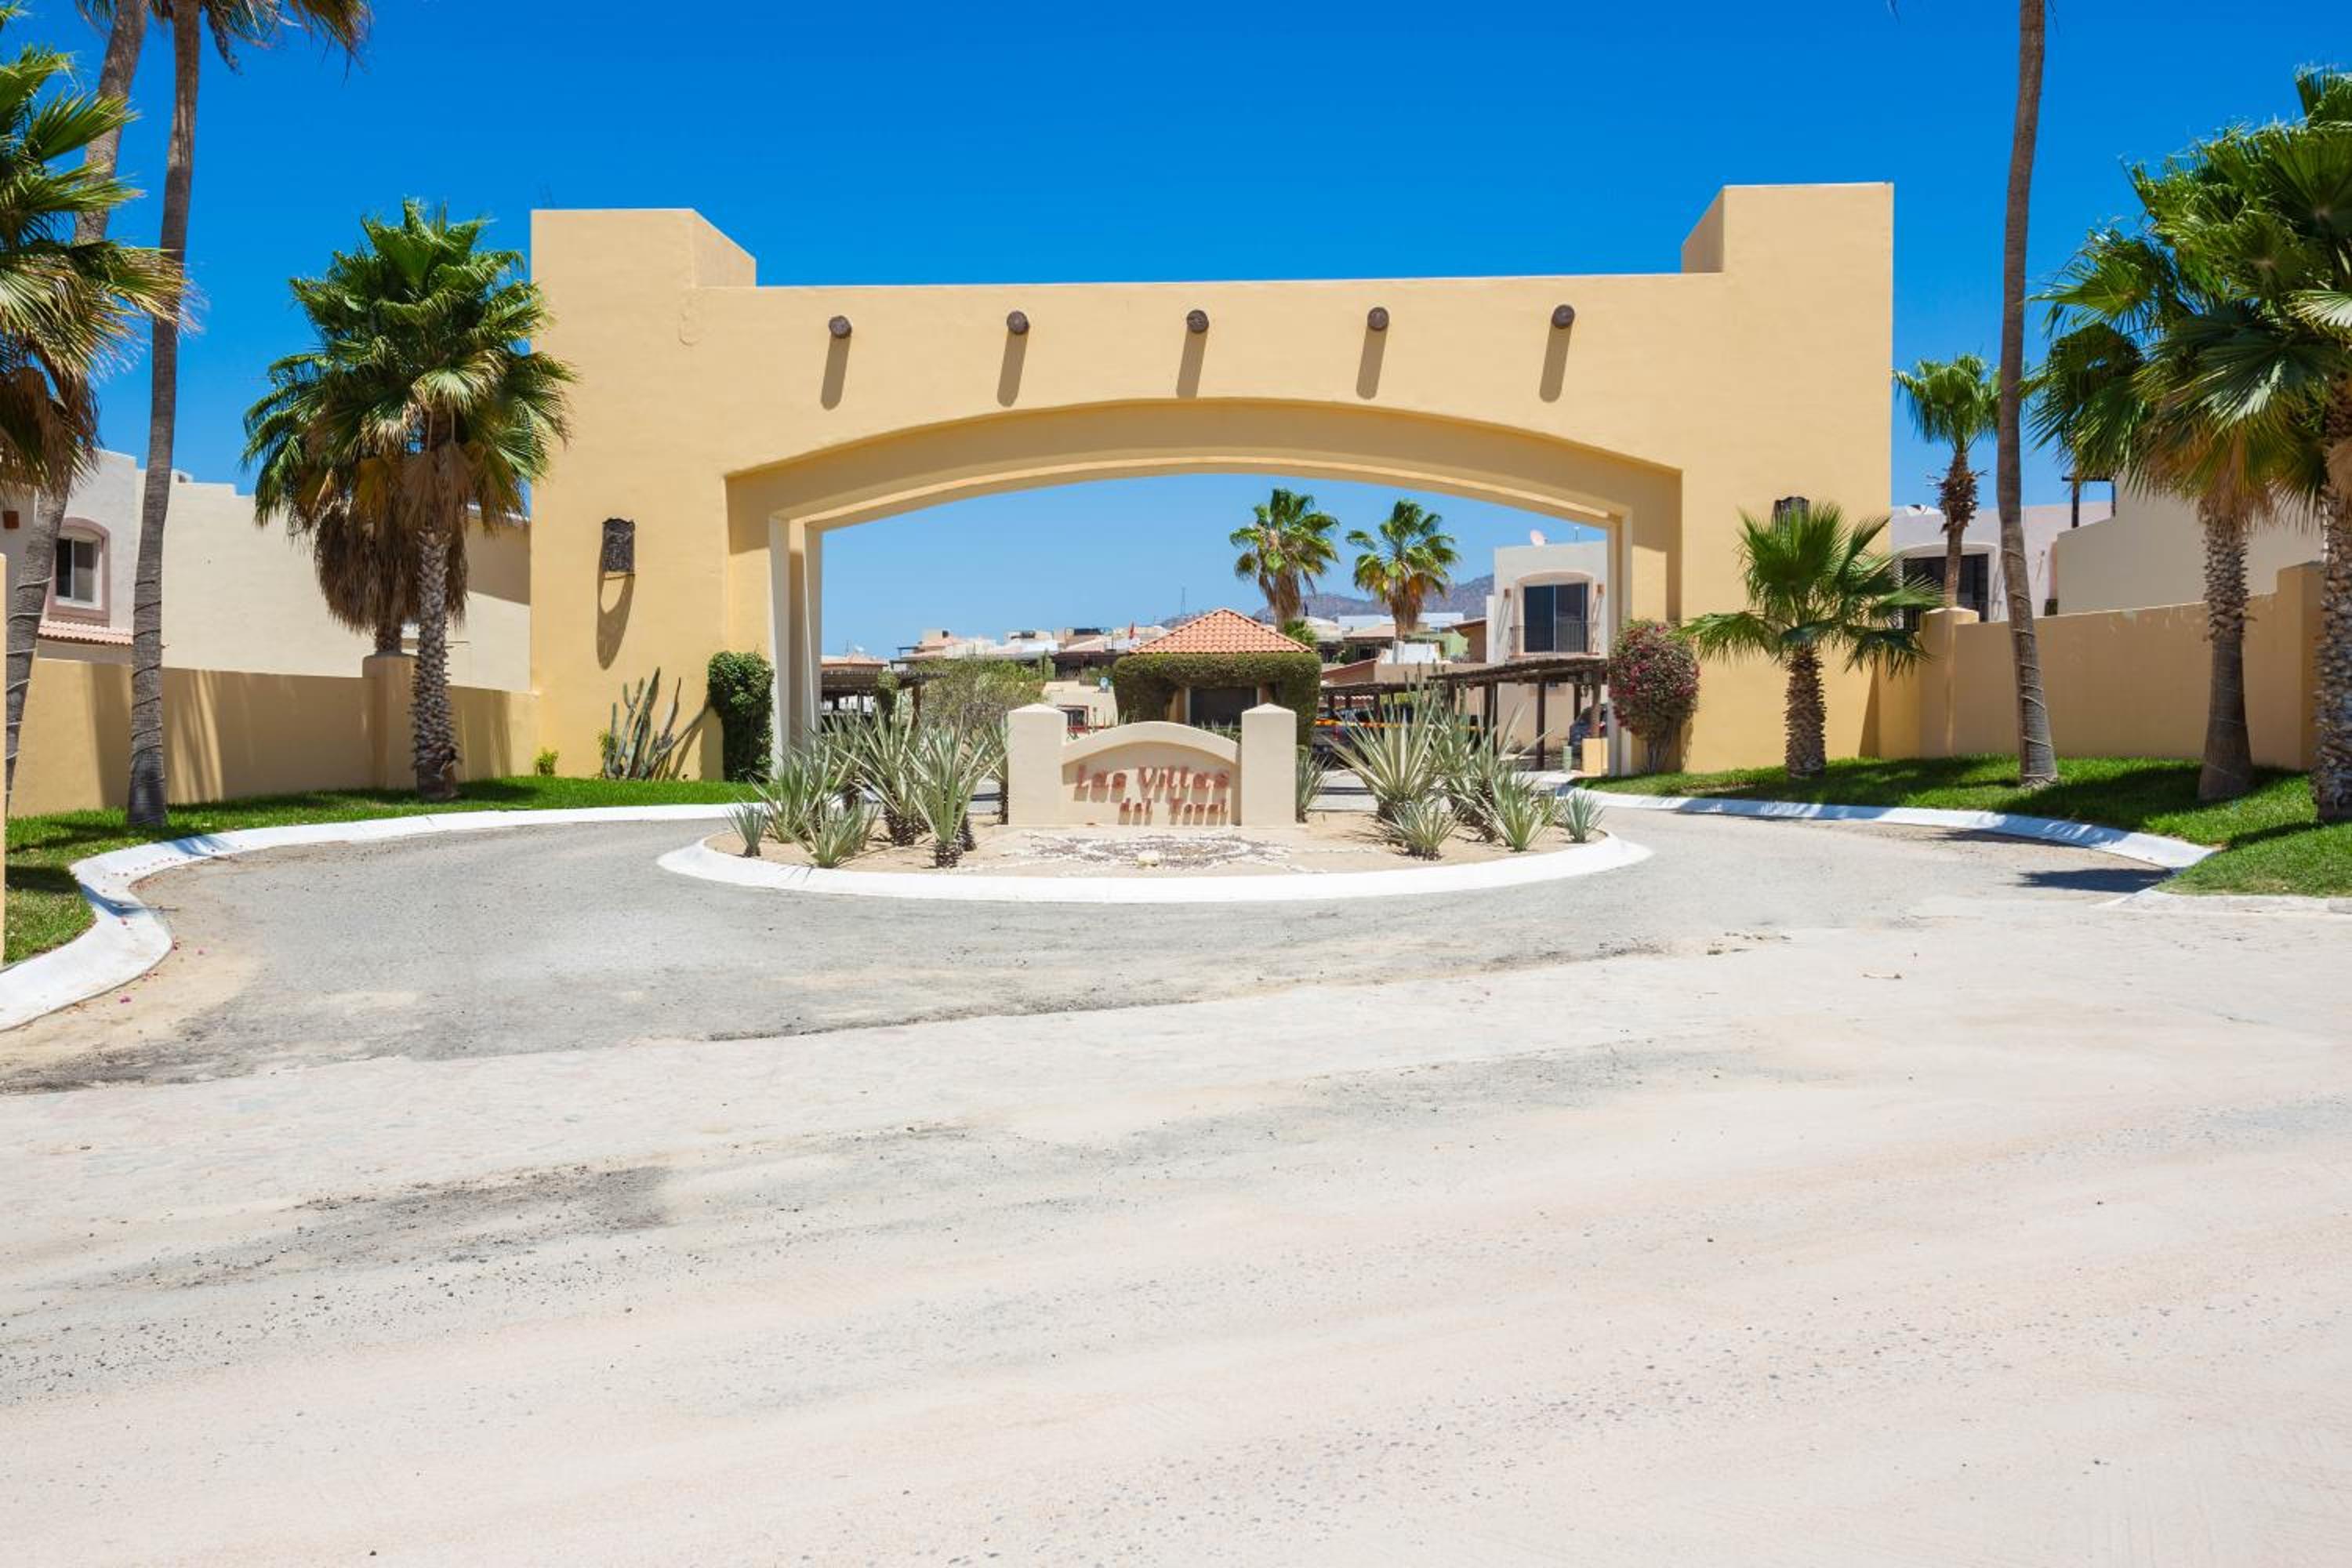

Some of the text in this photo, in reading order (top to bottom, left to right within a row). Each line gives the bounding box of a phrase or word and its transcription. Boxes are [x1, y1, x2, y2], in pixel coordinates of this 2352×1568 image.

[1076, 764, 1230, 790] Las Villas
[1120, 797, 1152, 814] del
